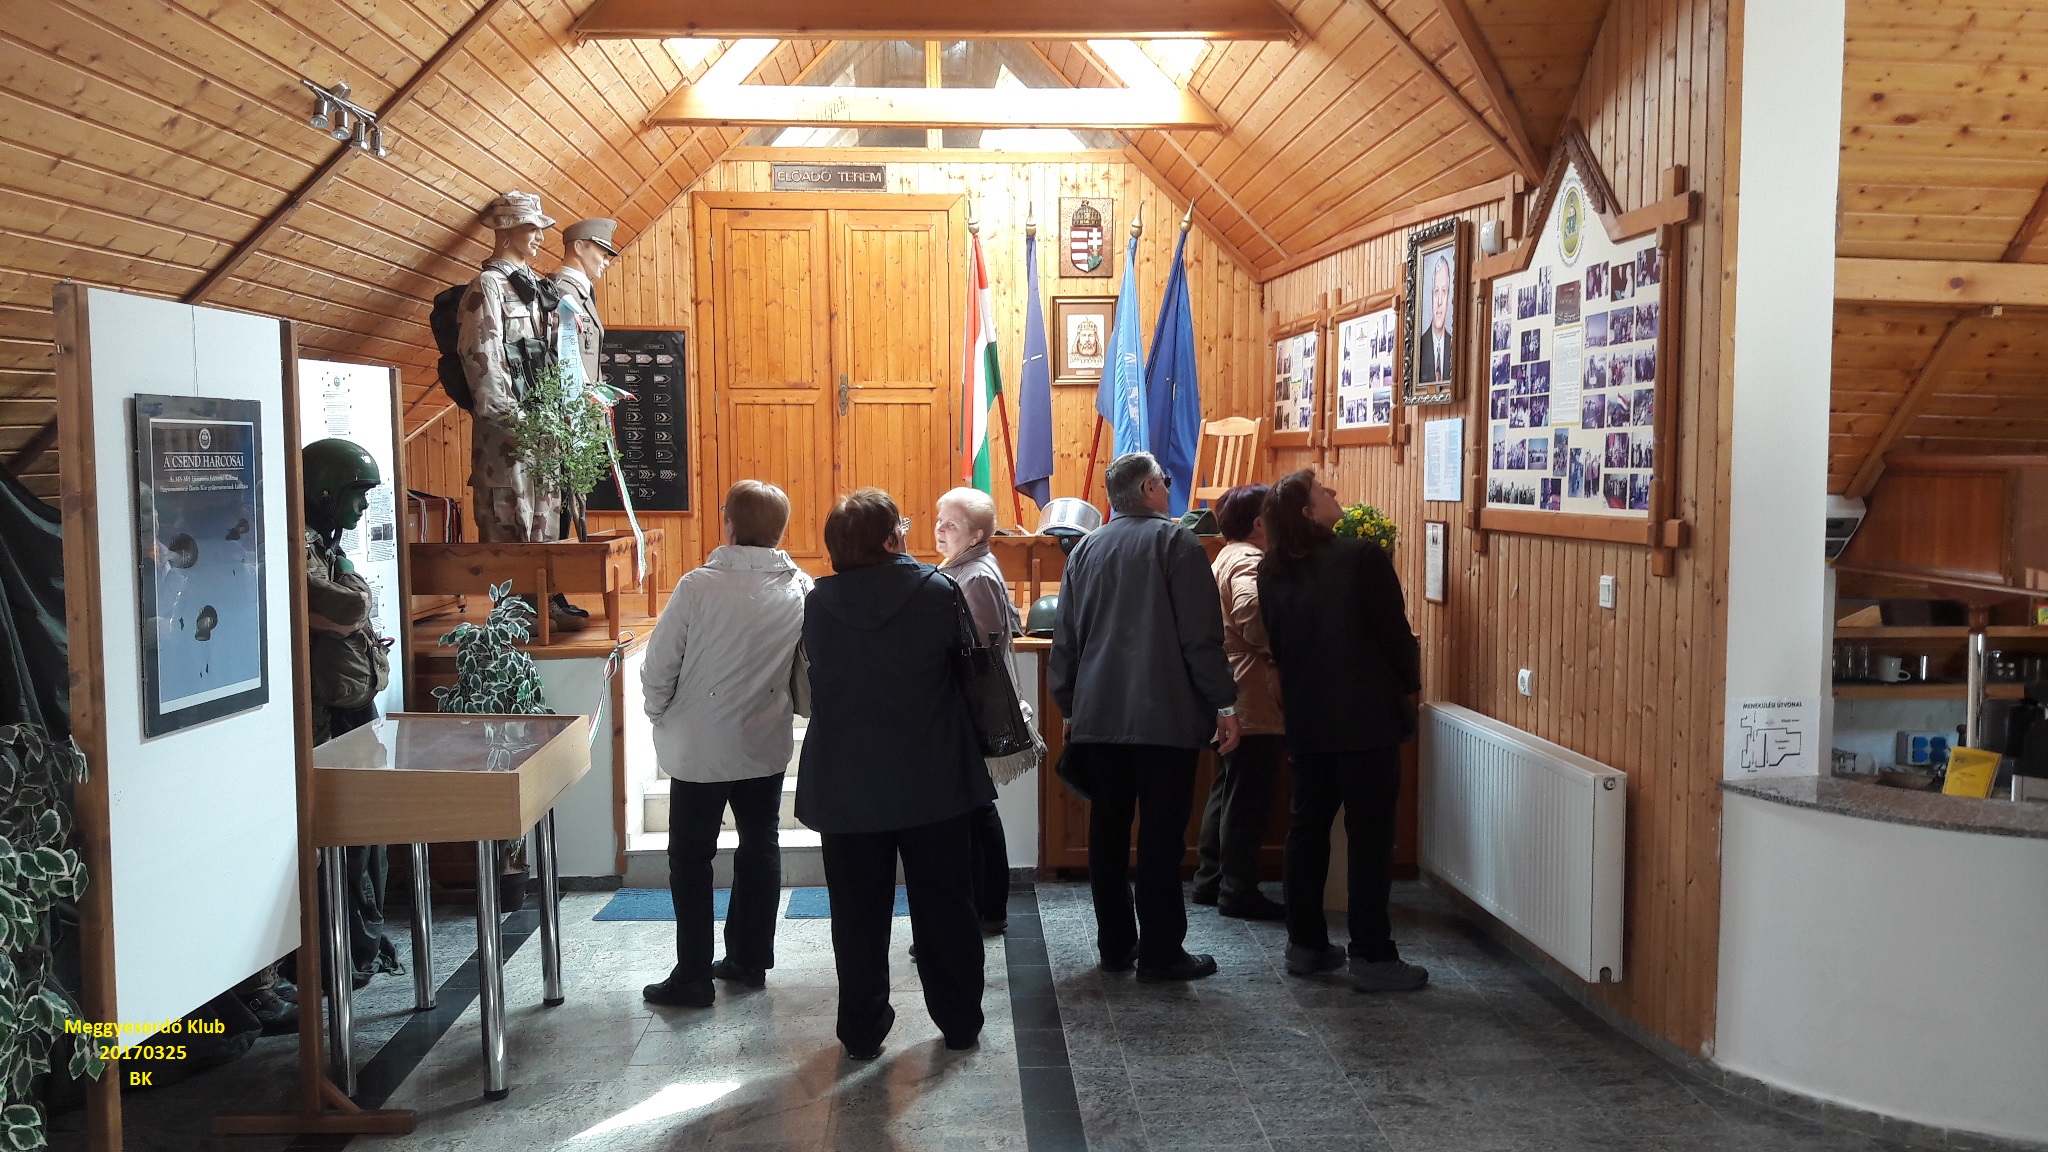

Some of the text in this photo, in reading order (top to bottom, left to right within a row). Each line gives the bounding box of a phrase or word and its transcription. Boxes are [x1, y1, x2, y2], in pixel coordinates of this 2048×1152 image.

[777, 167, 882, 182] ELŐADÓ TEREM
[163, 455, 244, 468] A CSEND HARCOSAI
